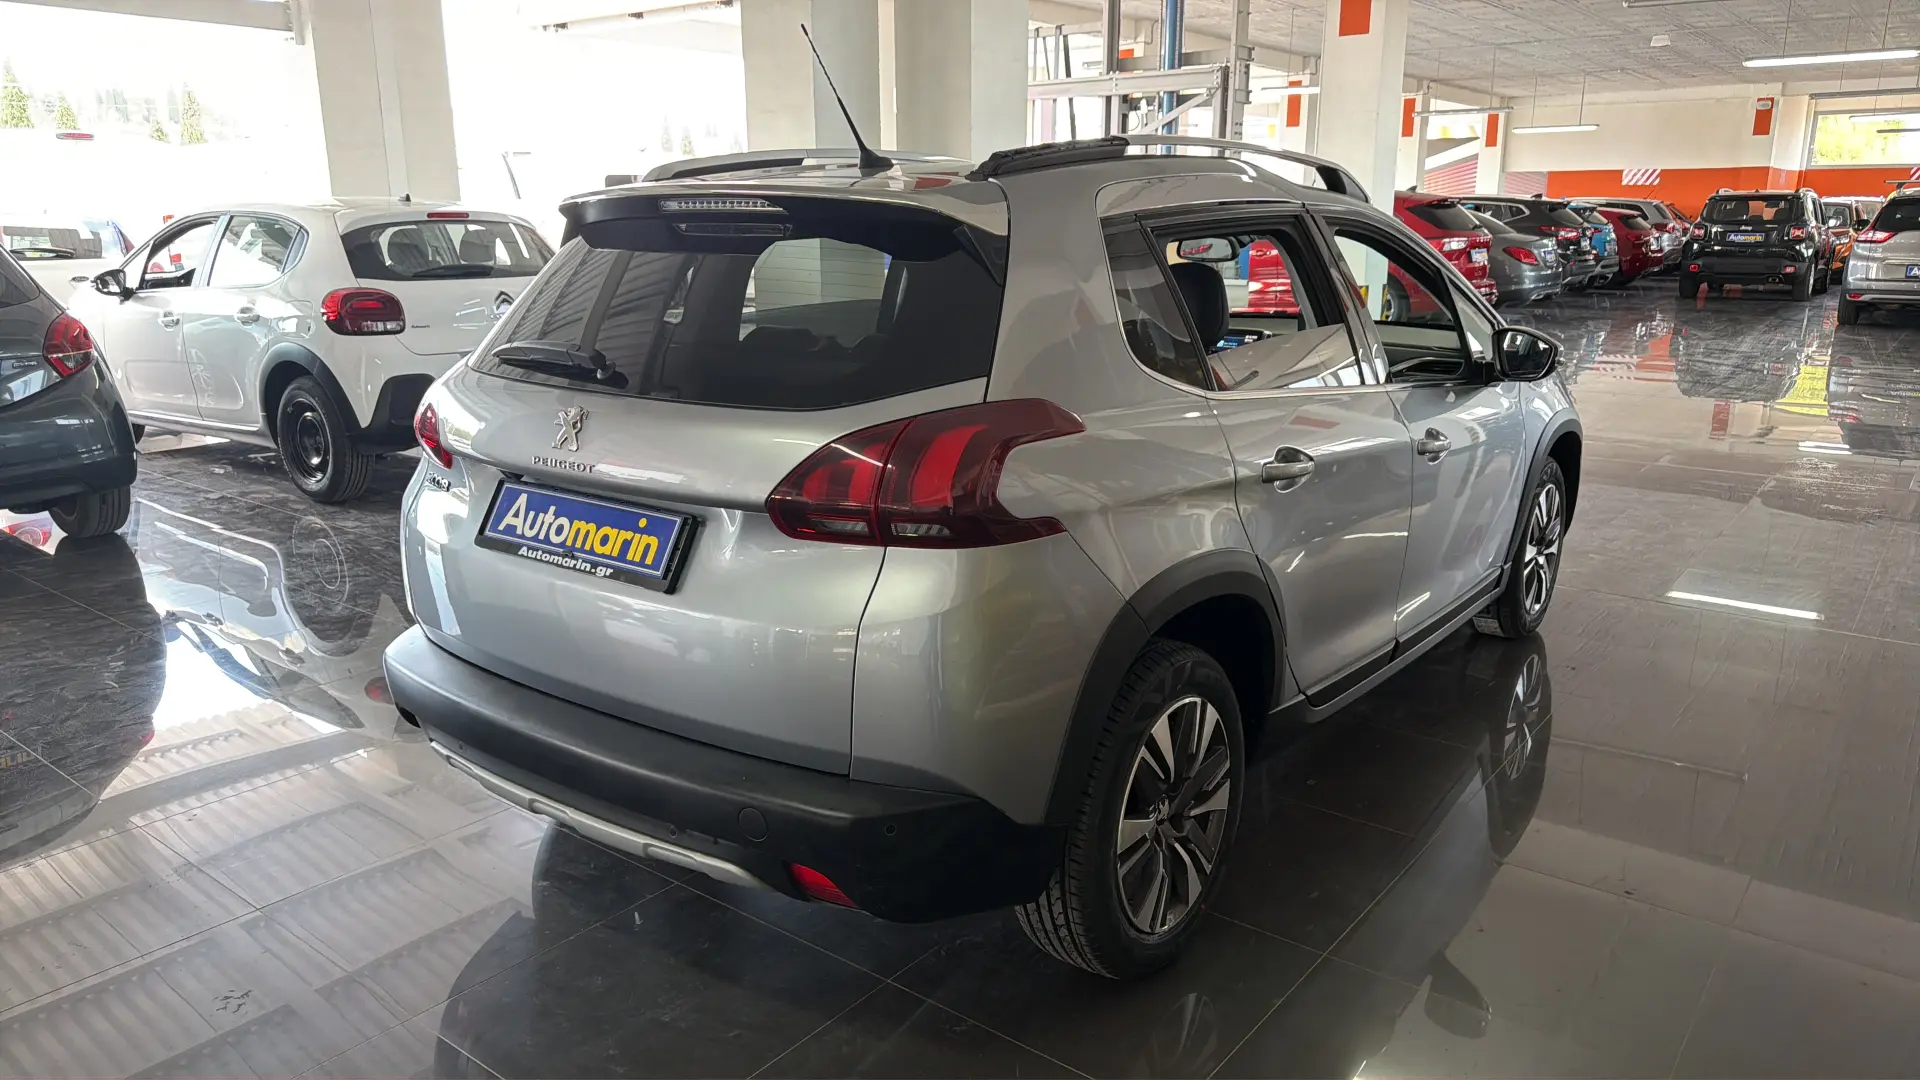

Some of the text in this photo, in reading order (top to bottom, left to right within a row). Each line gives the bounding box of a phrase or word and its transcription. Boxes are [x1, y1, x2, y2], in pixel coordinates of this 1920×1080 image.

[531, 455, 595, 473] PEUGEOT
[498, 493, 659, 565] Automarin
[518, 546, 613, 577] Automarin.gr
